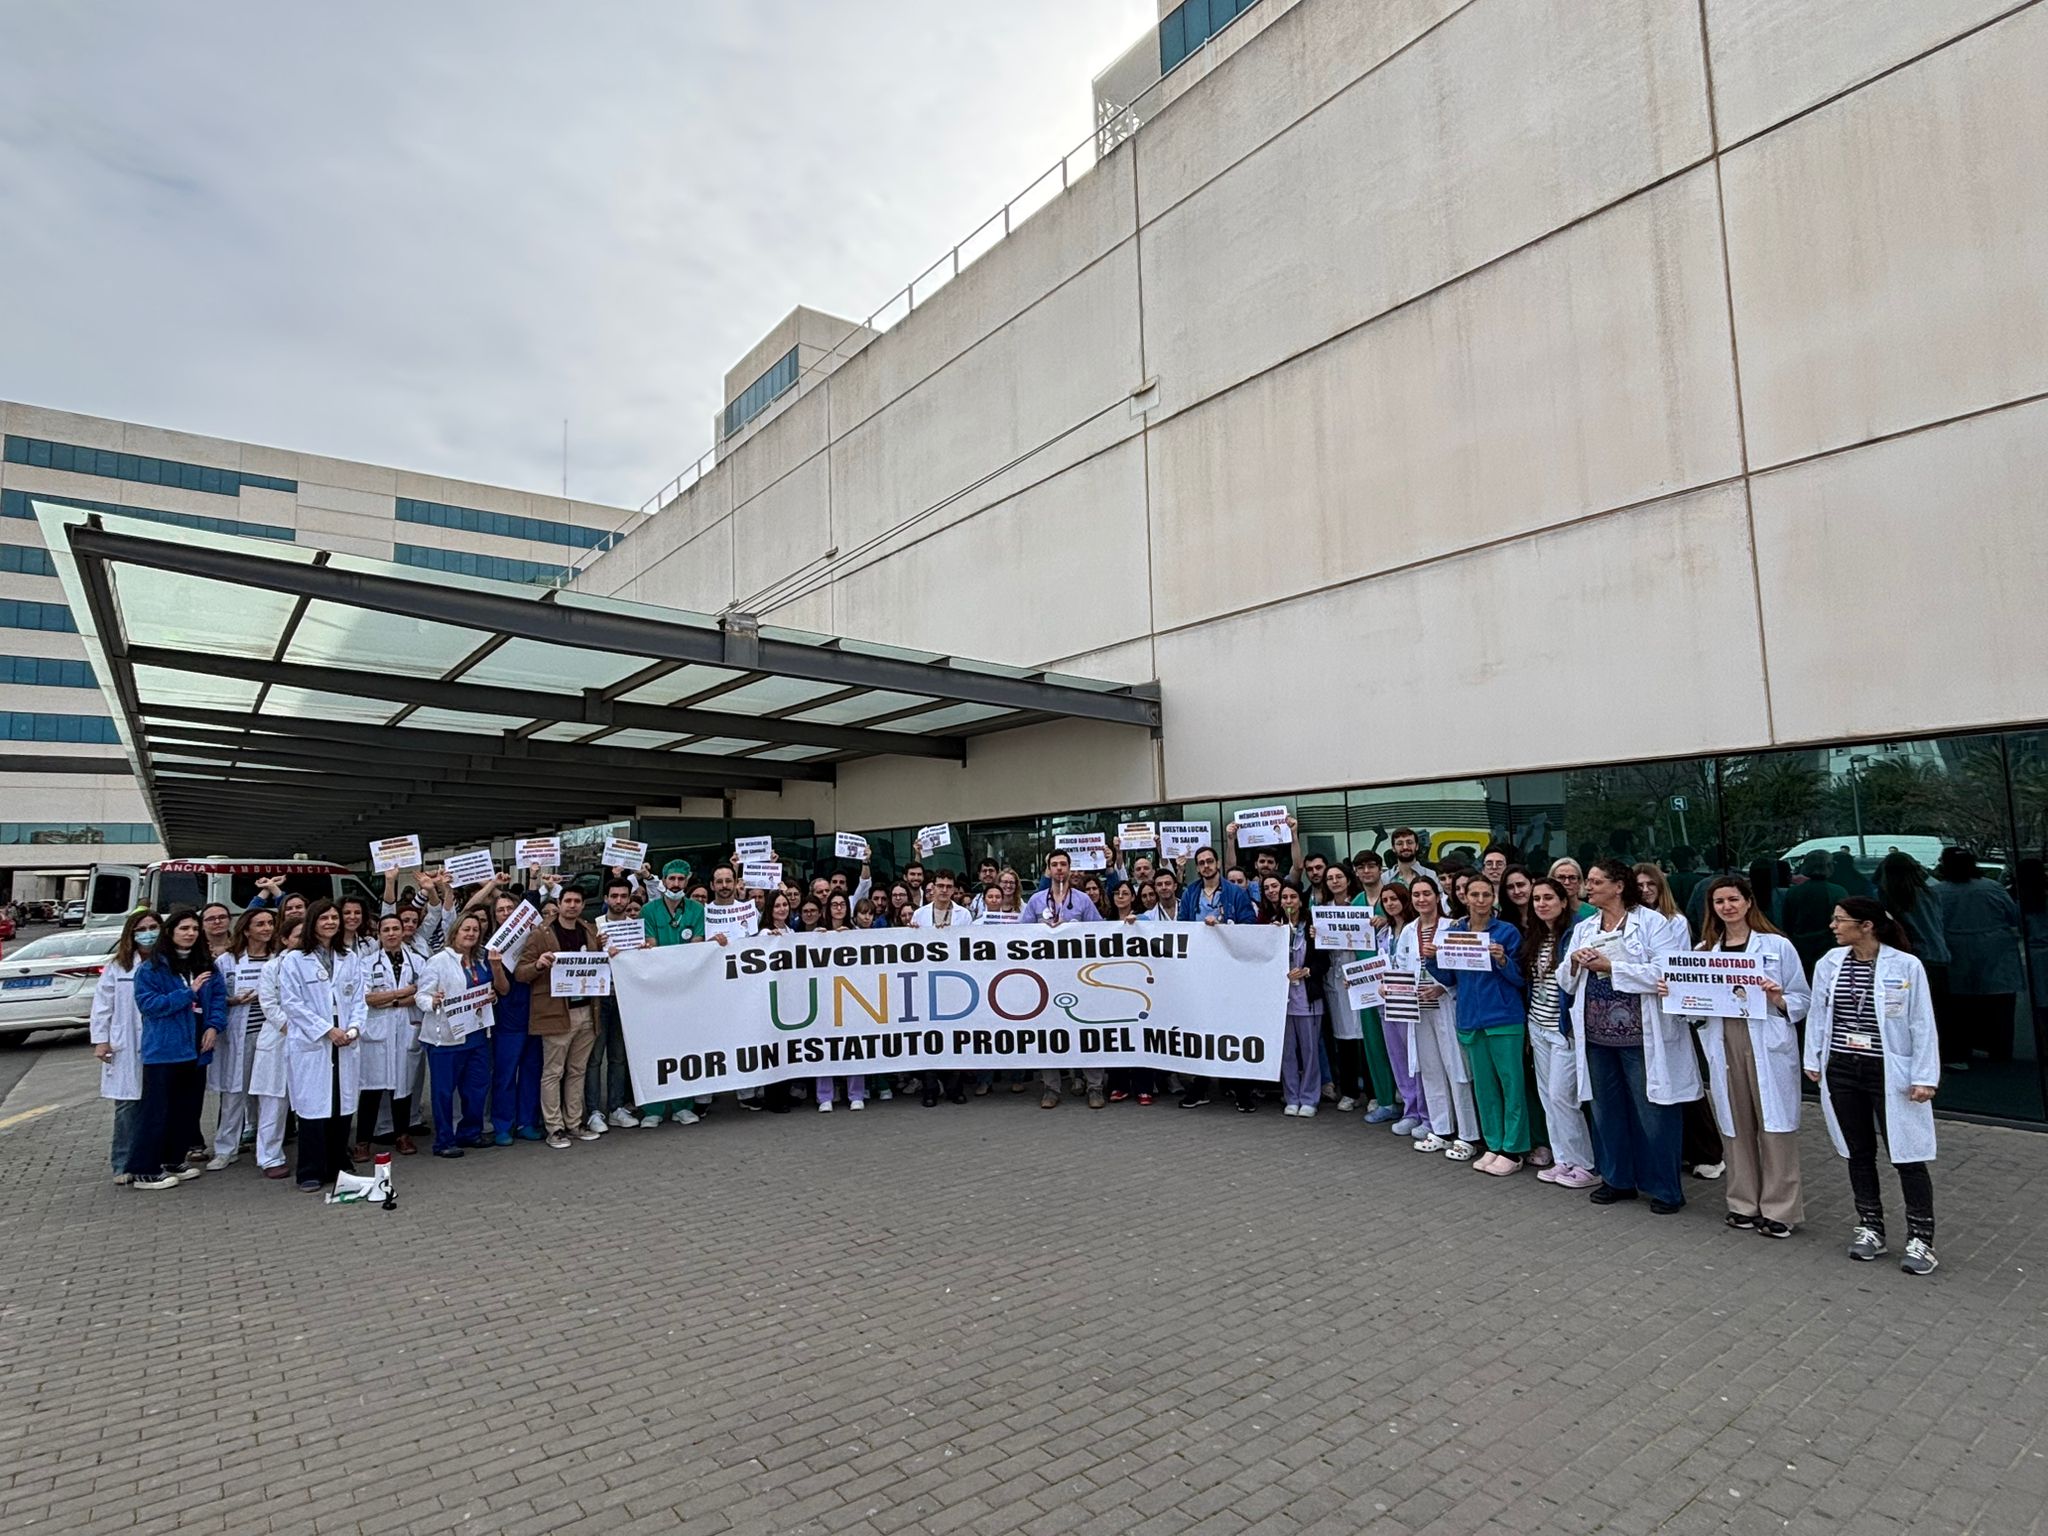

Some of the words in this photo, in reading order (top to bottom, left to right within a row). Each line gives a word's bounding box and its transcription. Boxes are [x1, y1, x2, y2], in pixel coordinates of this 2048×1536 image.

[1260, 809, 1284, 817] AGOTADO
[1162, 825, 1187, 833] NUESTRA
[1171, 836, 1179, 844] TU
[1180, 836, 1199, 844] SALUD
[228, 865, 331, 875] AMBULANCIA
[1315, 911, 1346, 919] NUESTRA
[1347, 911, 1370, 919] LUCHA
[1328, 923, 1337, 932] TU
[1337, 924, 1360, 932] SALUD
[556, 957, 587, 965] NUESTRA
[726, 941, 949, 980] ¡Salvemos
[960, 938, 996, 961] la
[1007, 933, 1189, 961] sanidad!
[1668, 955, 1707, 968] MÉDICO
[1708, 956, 1756, 969] AGOTADO
[566, 969, 574, 977] TU
[576, 969, 597, 977] SALUD
[1664, 972, 1710, 984] PACIENTE
[1711, 974, 1724, 984] EN
[1725, 975, 1763, 986] RIESGO
[769, 961, 1155, 1031] UNIDOS
[443, 996, 462, 1007] ÉDICO
[657, 1051, 727, 1086] POR
[736, 1042, 780, 1073] UN
[787, 1029, 943, 1065] ESTATUTO
[953, 1028, 1071, 1055] PROPIO
[1080, 1027, 1136, 1054] DEL
[1143, 1026, 1265, 1064] MÉDICO
